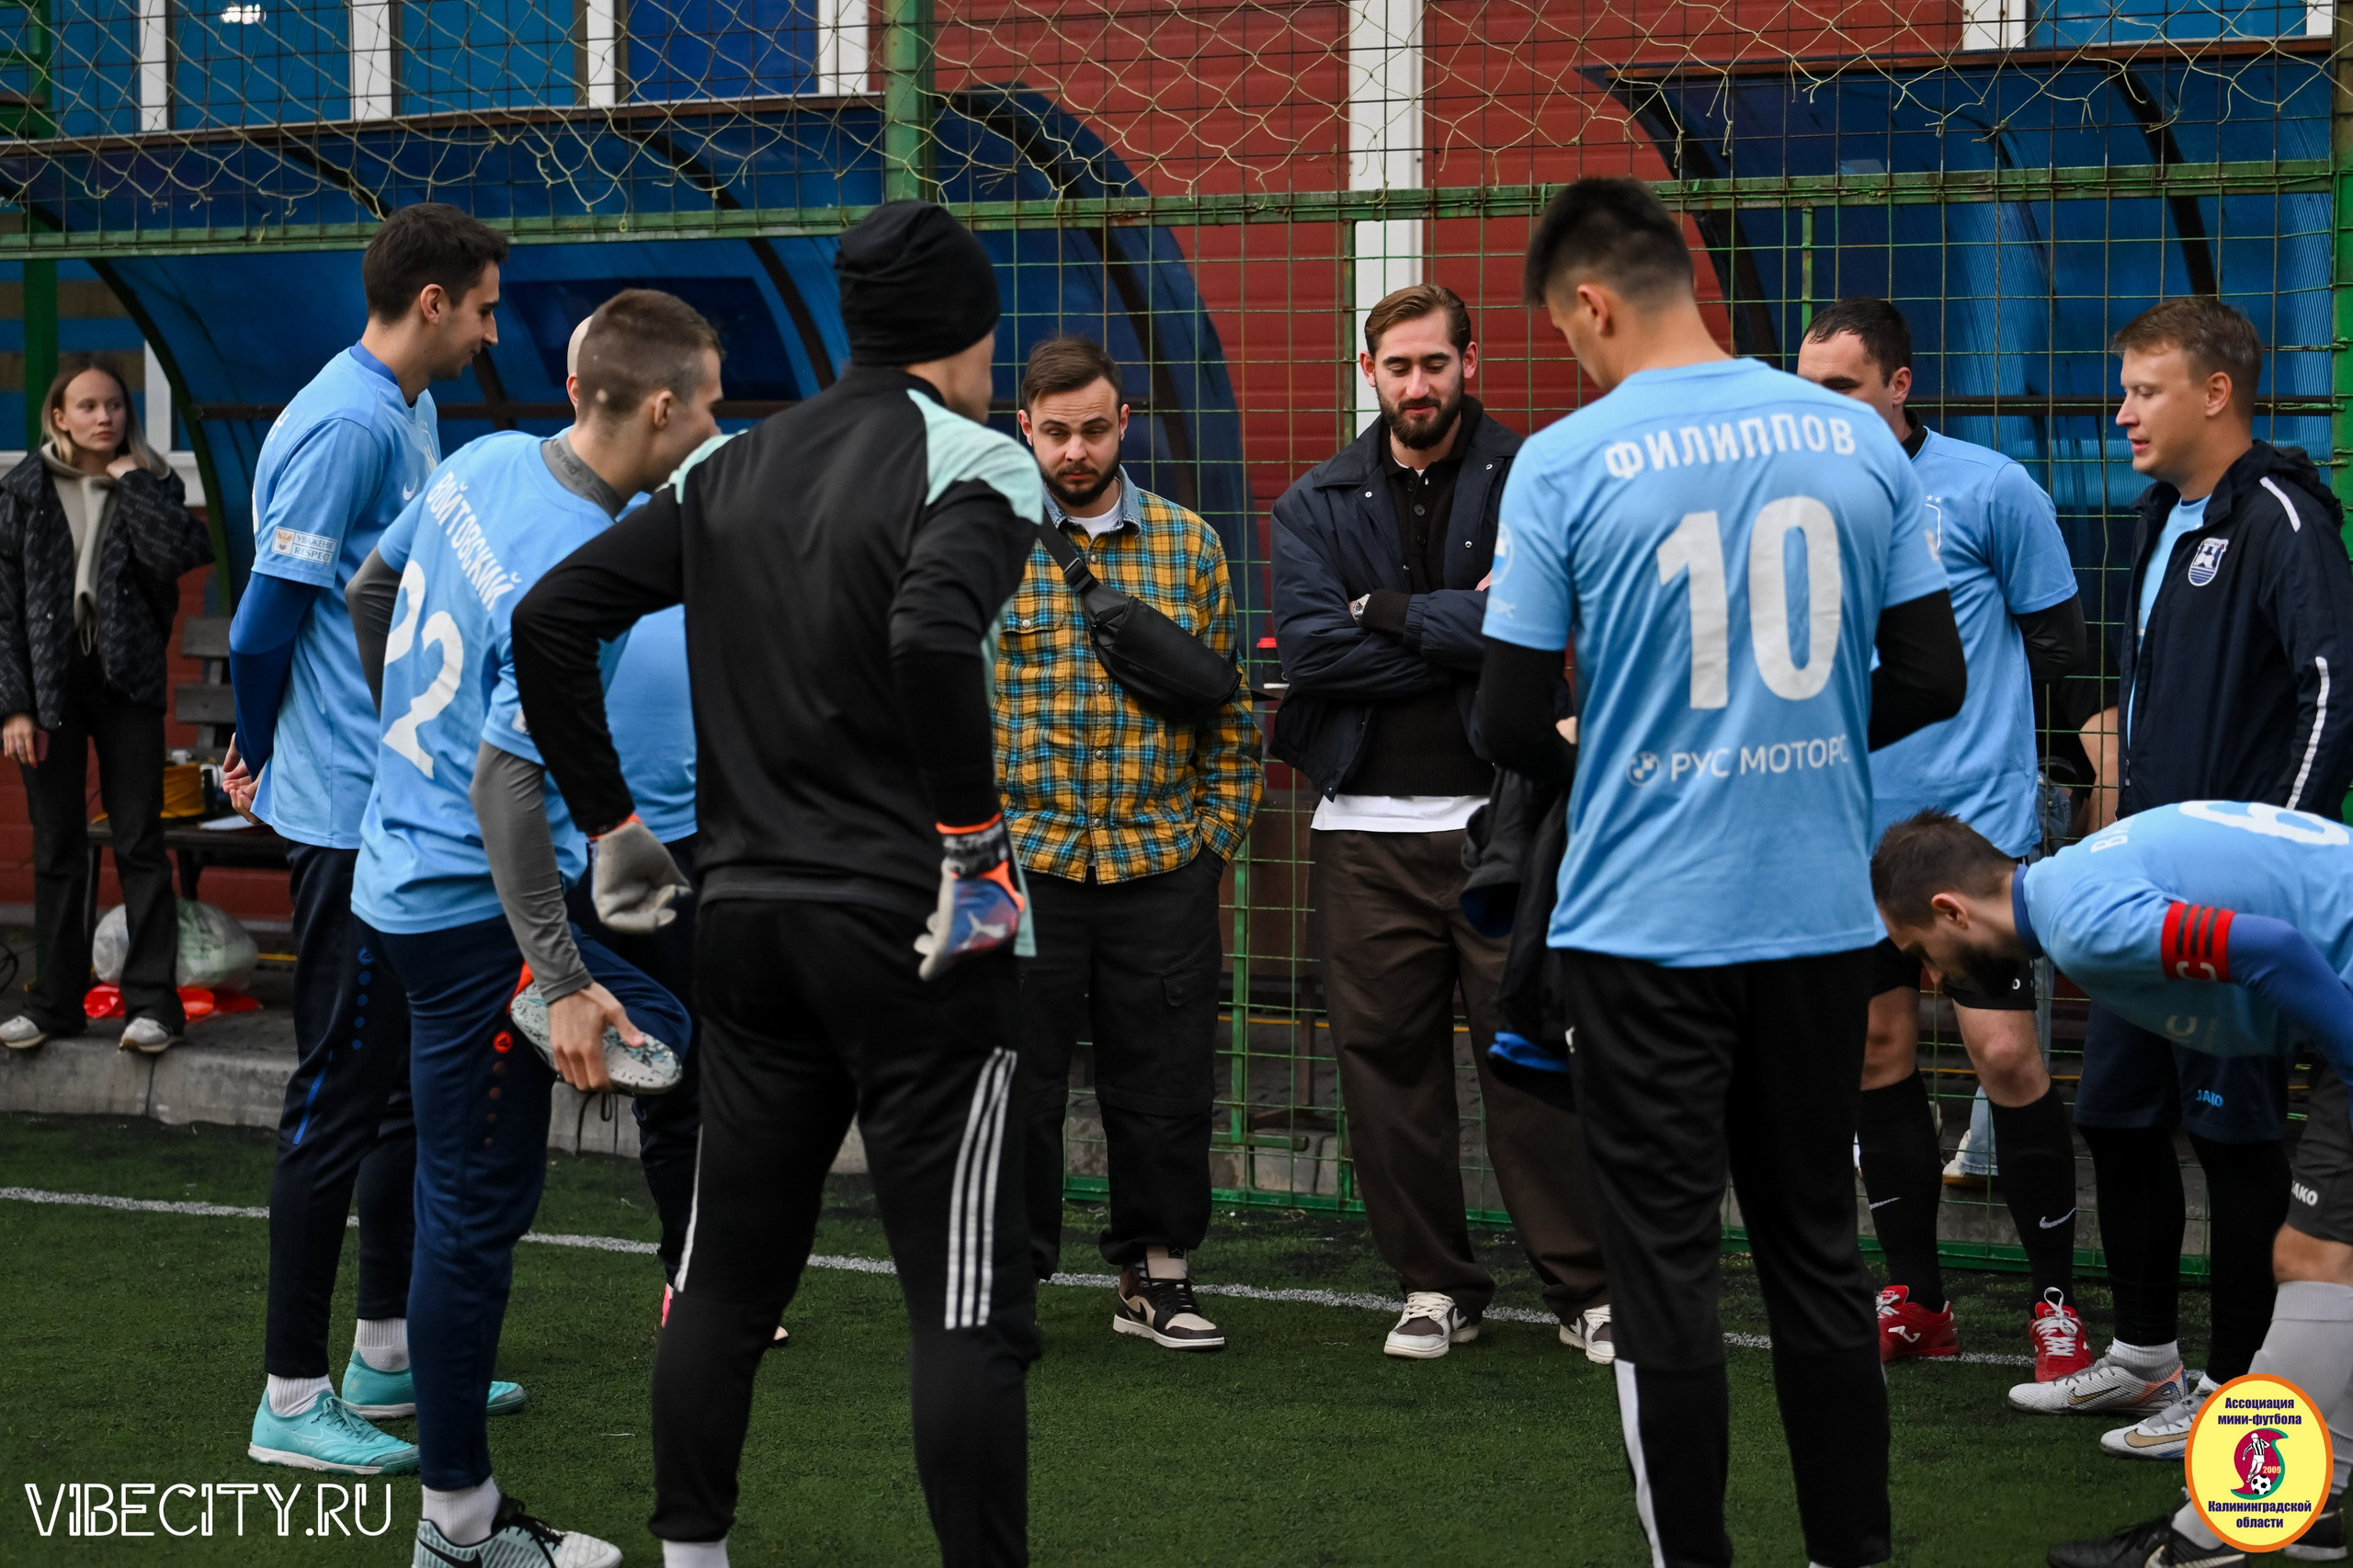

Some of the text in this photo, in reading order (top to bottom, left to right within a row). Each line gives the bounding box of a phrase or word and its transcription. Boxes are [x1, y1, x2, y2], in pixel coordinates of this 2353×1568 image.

[1604, 413, 1856, 479] ФИЛИППОВ
[294, 547, 331, 562] RESPECT
[426, 471, 522, 611] ВОЙТОВСКИЙ
[1657, 495, 1841, 710] 10
[381, 559, 464, 780] 22
[1671, 748, 1730, 781] РУС
